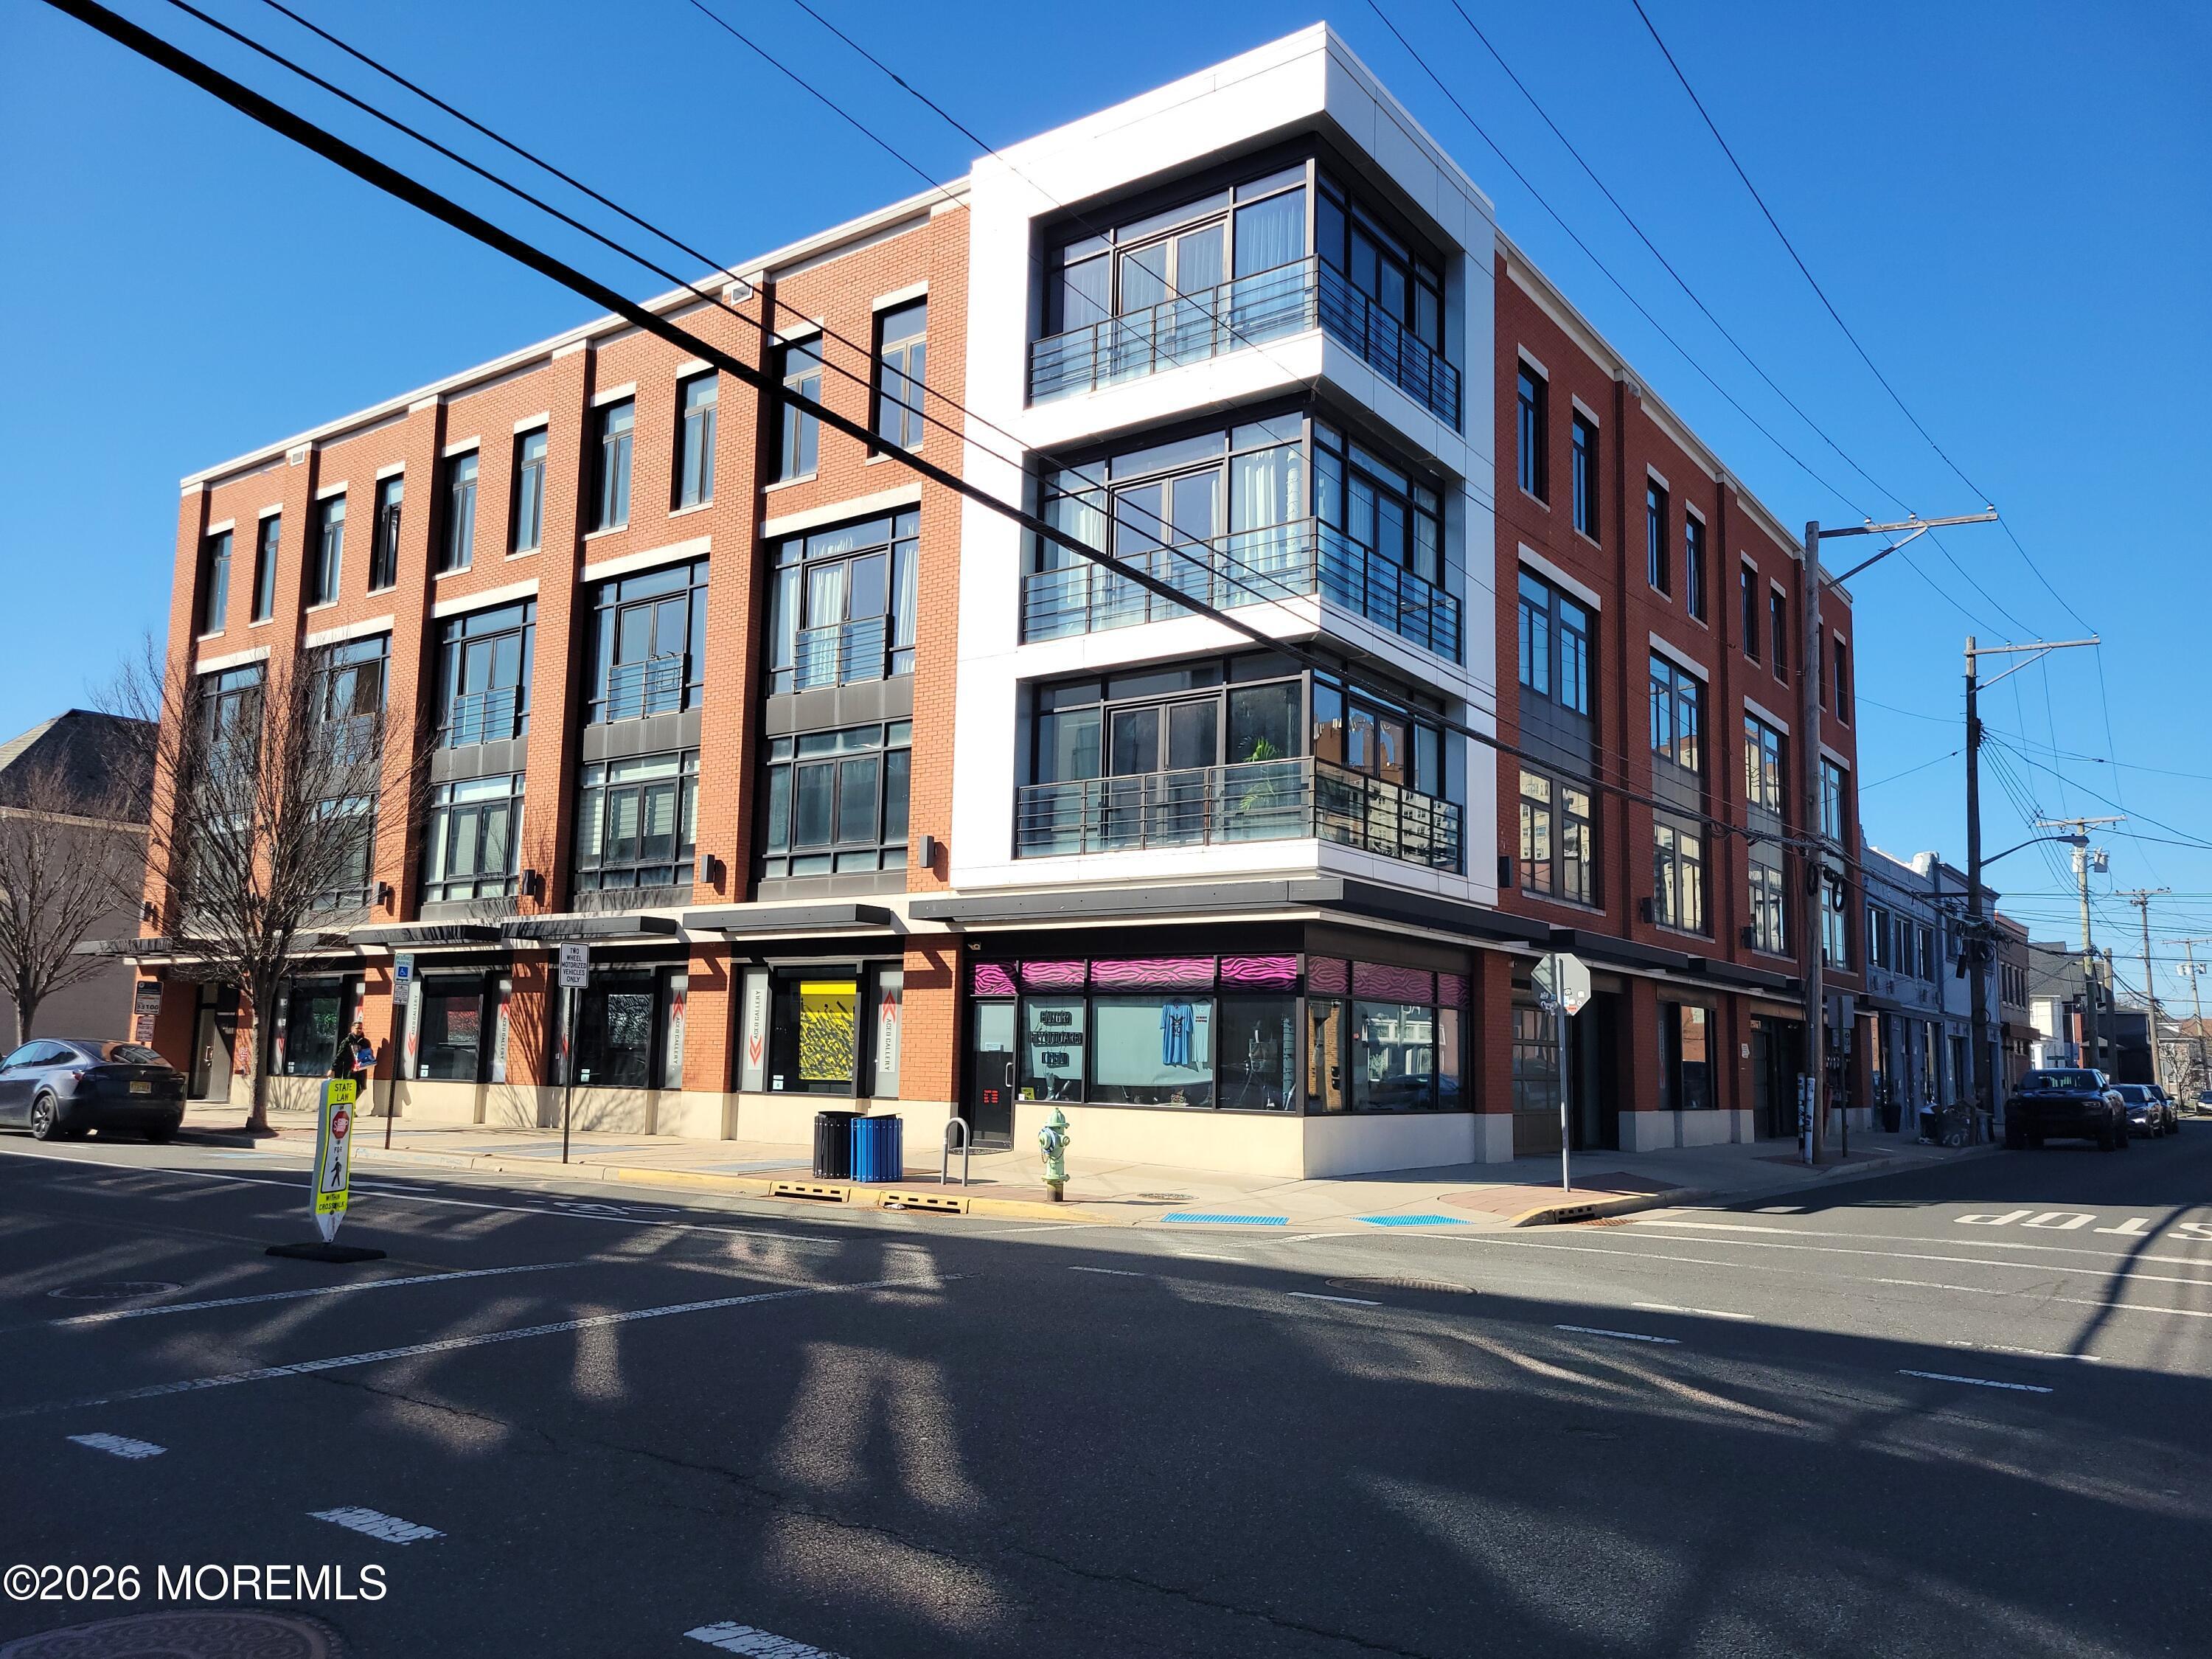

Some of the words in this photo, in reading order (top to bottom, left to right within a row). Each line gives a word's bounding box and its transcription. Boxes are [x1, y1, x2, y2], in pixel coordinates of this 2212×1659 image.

[563, 968, 585, 976] VEHICLES
[566, 975, 581, 984] ONLY
[335, 1082, 352, 1092] STATE
[336, 1093, 349, 1102] LAW
[333, 1146, 343, 1154] FOR
[319, 1201, 345, 1211] CROSSWALK
[1953, 1209, 2212, 1242] STOP
